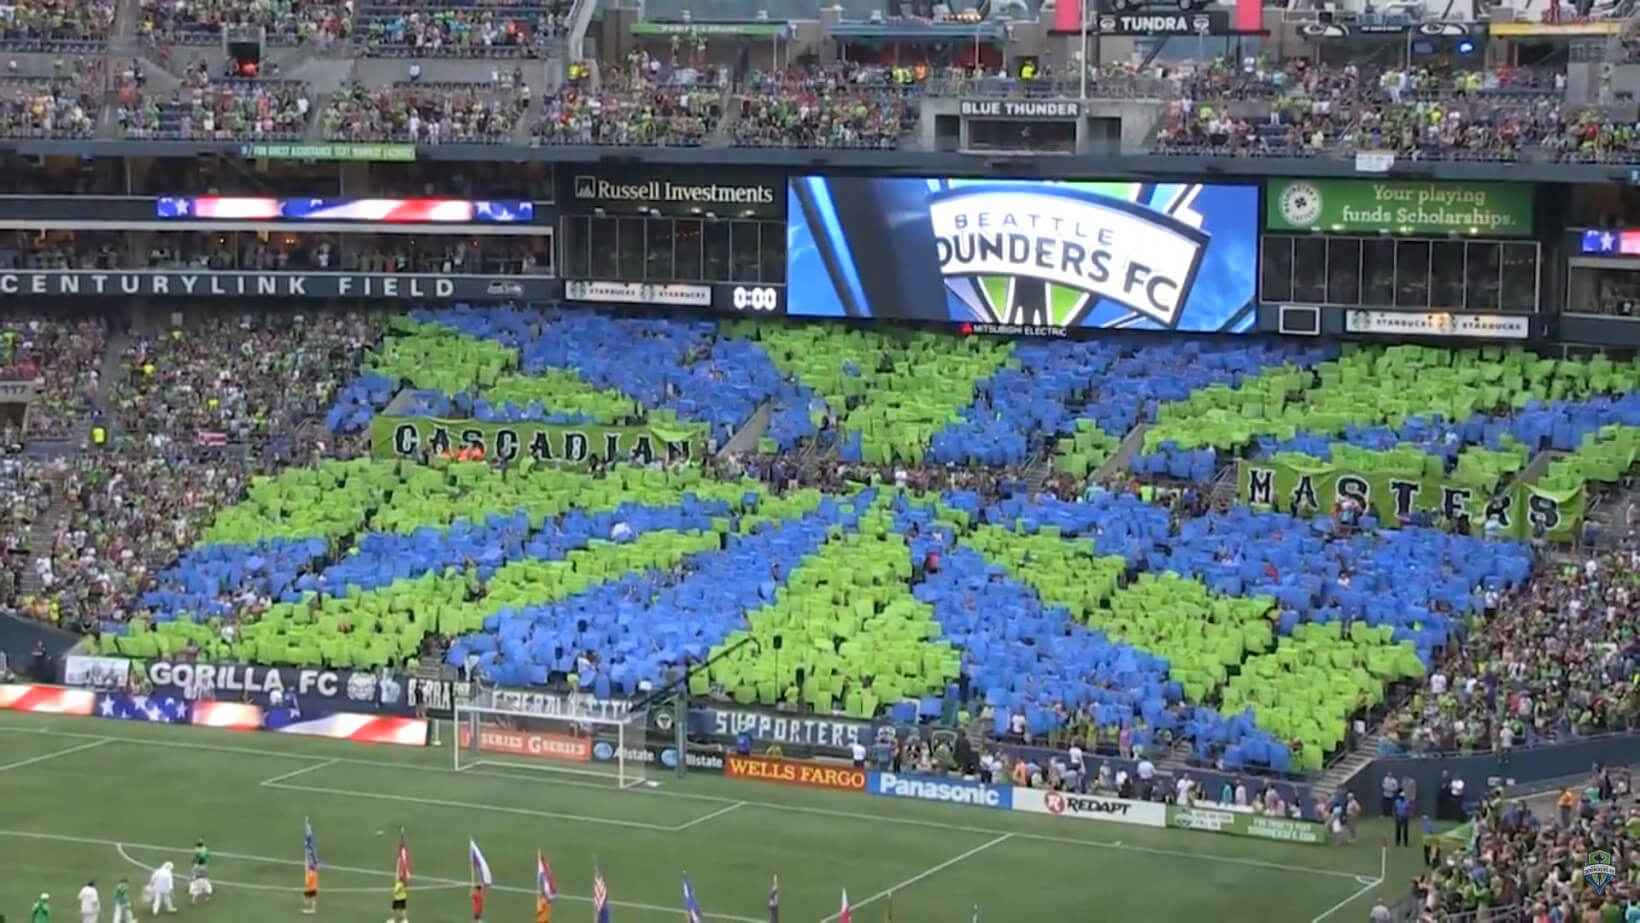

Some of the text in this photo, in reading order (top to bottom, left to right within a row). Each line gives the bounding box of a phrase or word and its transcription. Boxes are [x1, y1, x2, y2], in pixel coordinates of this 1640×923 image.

[1121, 16, 1188, 31] TUNDRA
[961, 101, 1079, 117] BLUE THUNDER
[598, 181, 773, 204] Russell Investments
[1373, 186, 1486, 206] Your playing
[954, 212, 1115, 246] SEATTLE
[1343, 206, 1517, 227] funds Scholarships.
[0, 275, 457, 298] CENTURYLINK FIELD
[733, 286, 777, 311] 0:00
[1123, 259, 1178, 313] FC
[973, 324, 1067, 337] MITSUBISHI ELECTRIC
[394, 422, 692, 465] CASCADIAN
[1247, 468, 1560, 534] MASTERS
[150, 661, 338, 697] GORILLA FC
[408, 677, 451, 710] BRRA
[715, 710, 860, 748] SUPPORTERS
[686, 751, 724, 769] llstate
[730, 757, 866, 789] WELLS FARGO
[880, 774, 999, 807] Panasonic
[1067, 798, 1132, 817] REDAPT
